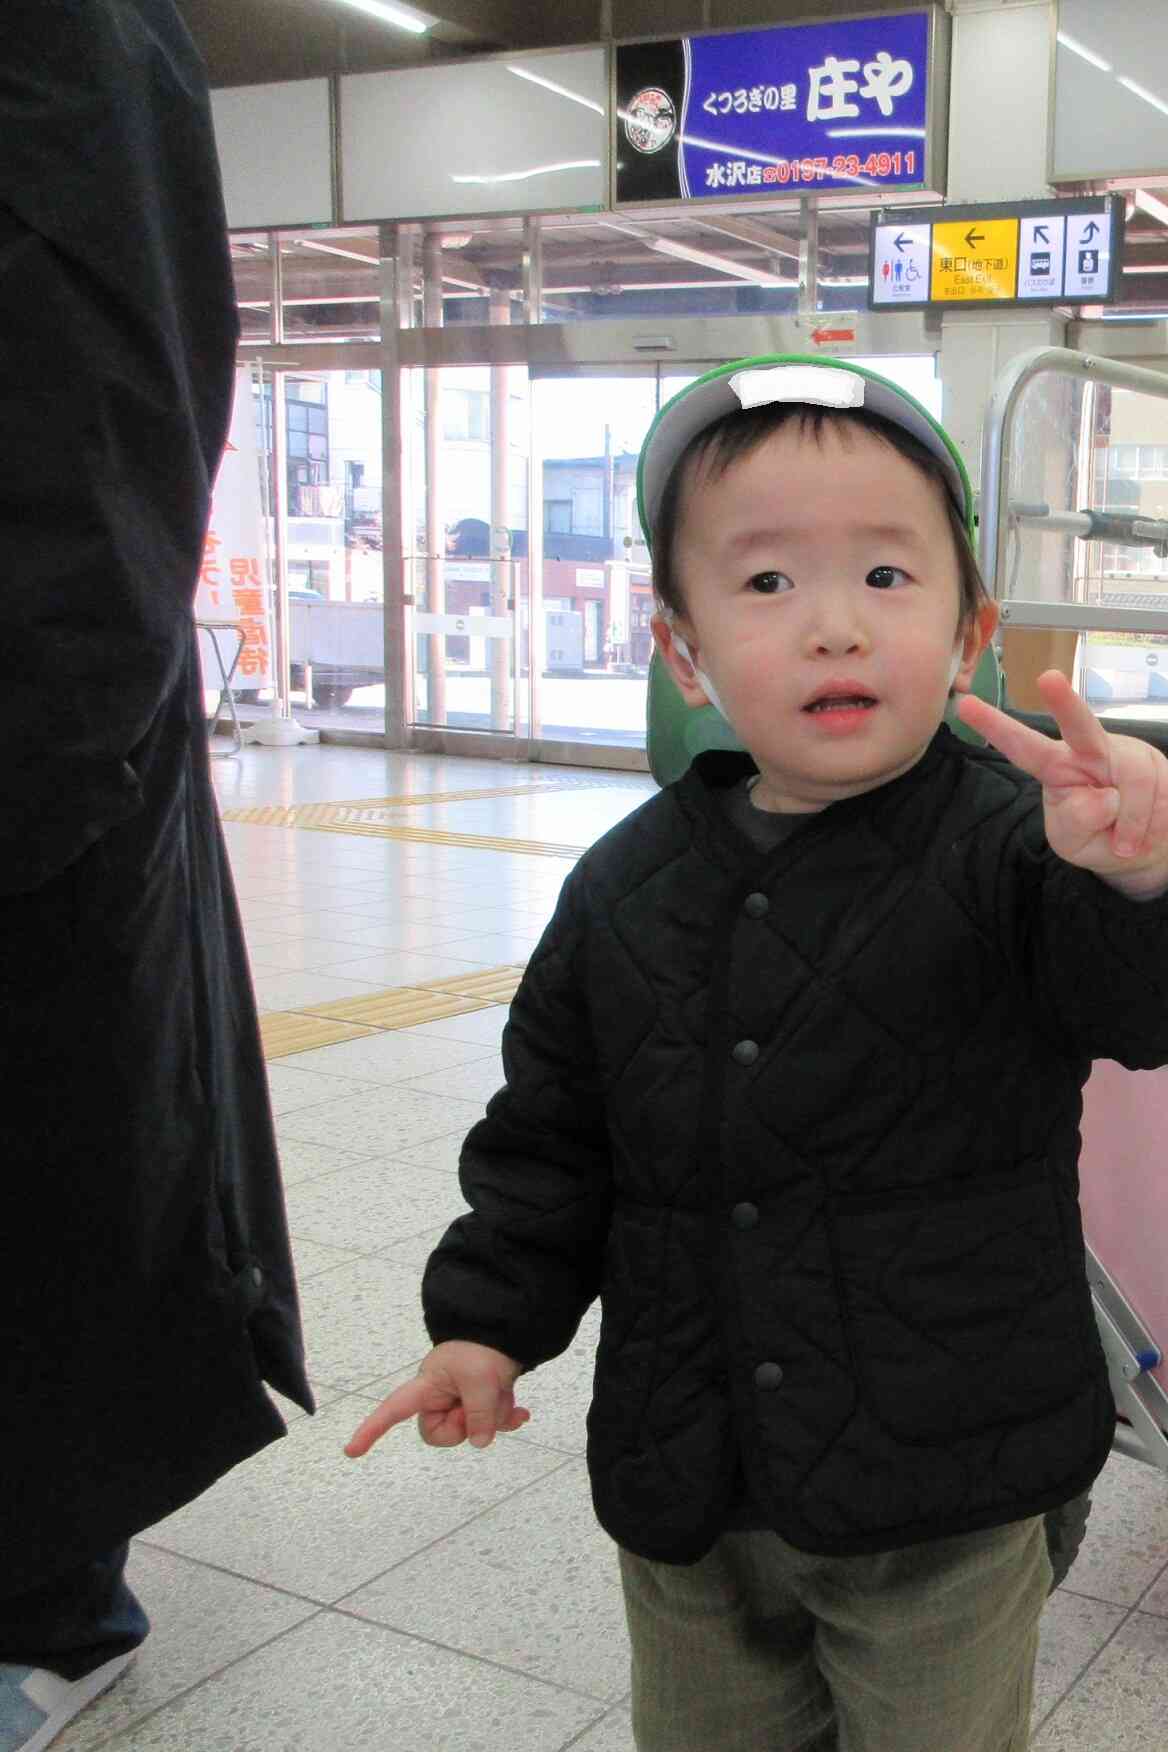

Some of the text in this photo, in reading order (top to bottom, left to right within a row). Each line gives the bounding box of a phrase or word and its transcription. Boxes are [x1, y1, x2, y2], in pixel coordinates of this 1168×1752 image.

[703, 84, 797, 116] くつろぎの里
[806, 52, 914, 122] 庄や
